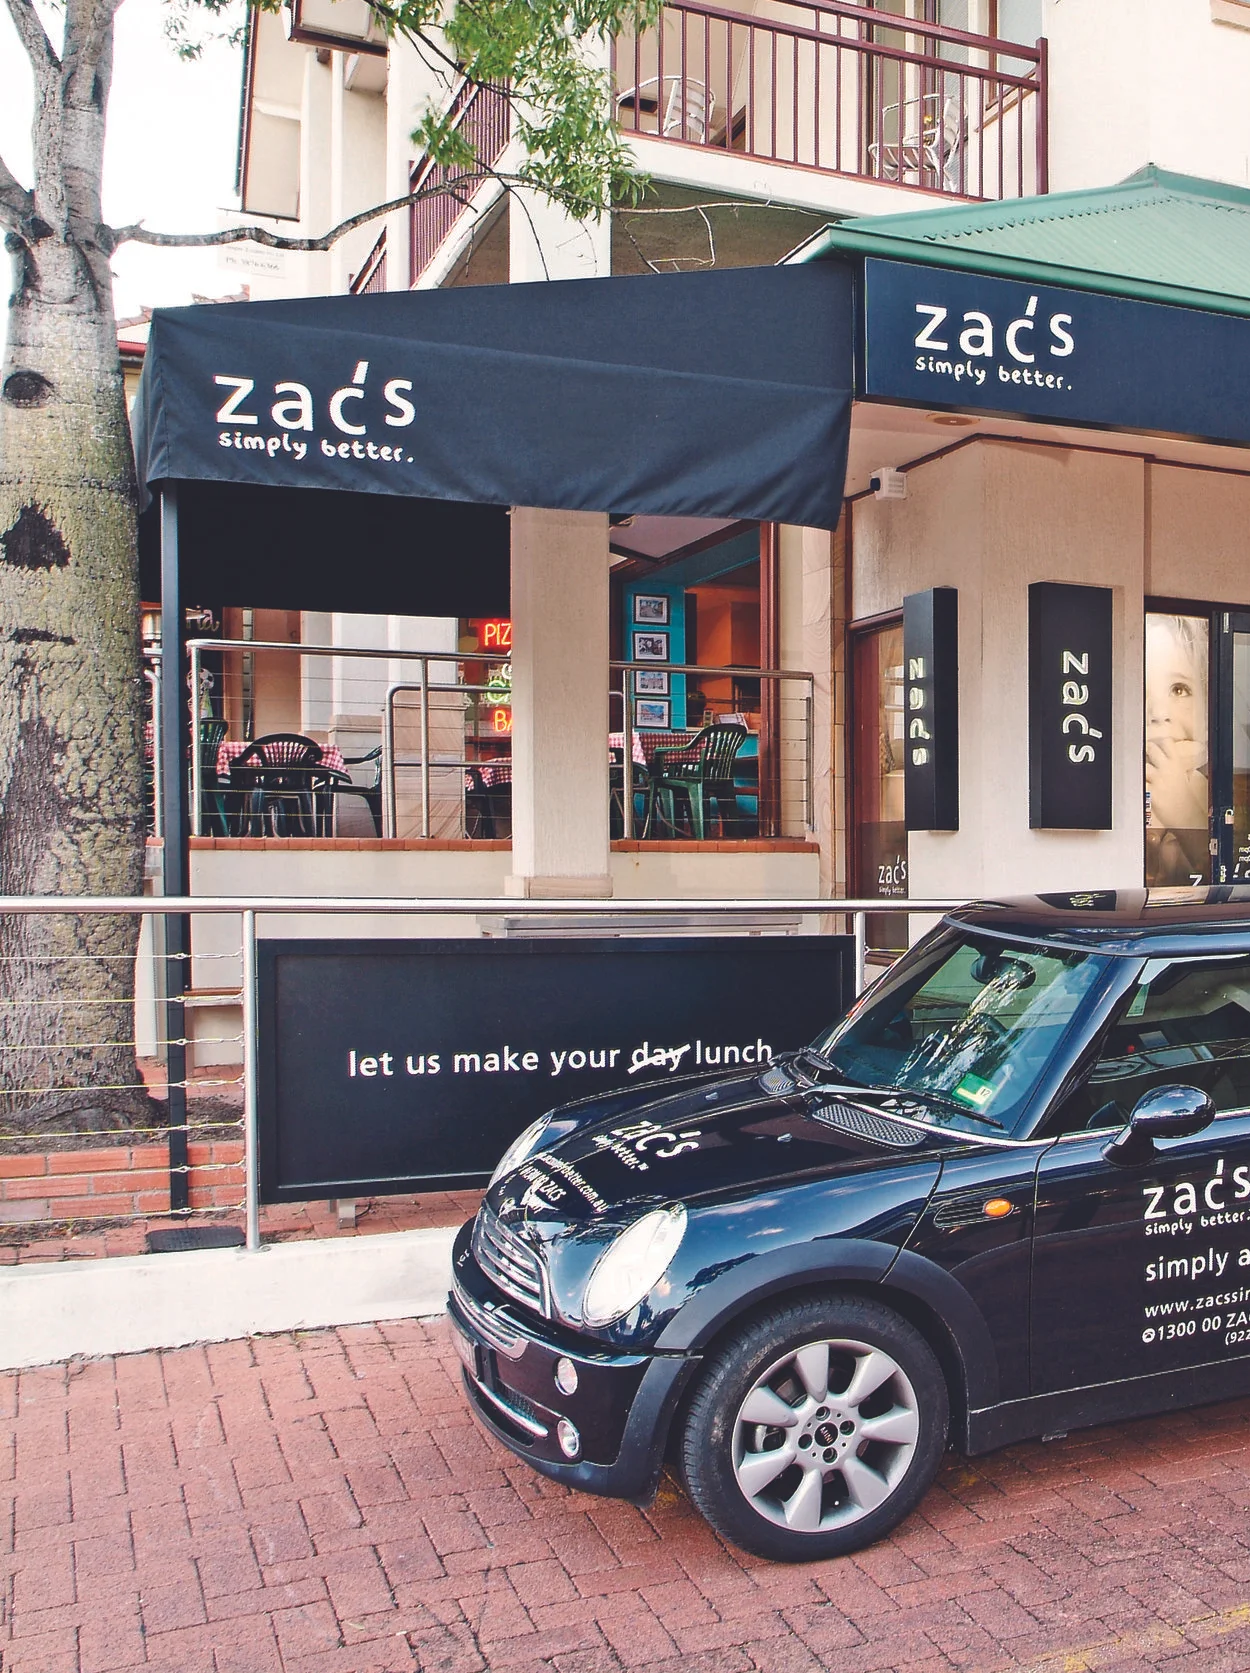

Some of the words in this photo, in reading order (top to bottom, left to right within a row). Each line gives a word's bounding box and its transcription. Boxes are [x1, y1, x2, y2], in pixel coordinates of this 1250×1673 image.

[914, 295, 1075, 364] zac's
[915, 356, 987, 386] simply
[998, 365, 1072, 391] better.
[214, 360, 416, 435] zac's
[218, 431, 308, 460] simply
[320, 439, 414, 463] better.
[1062, 651, 1103, 763] zac's
[878, 854, 907, 885] zac's
[349, 1050, 394, 1077] let
[406, 1054, 441, 1075] us
[453, 1045, 539, 1073] make
[550, 1049, 621, 1077] your
[629, 1041, 687, 1073] day
[696, 1038, 773, 1065] lunch
[539, 1180, 567, 1201] ZACS
[1142, 1158, 1250, 1220] zac's
[1145, 1218, 1193, 1236] simply
[1145, 1247, 1229, 1282] simply
[1237, 1248, 1250, 1266] a
[1158, 1320, 1196, 1341] 1300
[1201, 1315, 1221, 1333] 00
